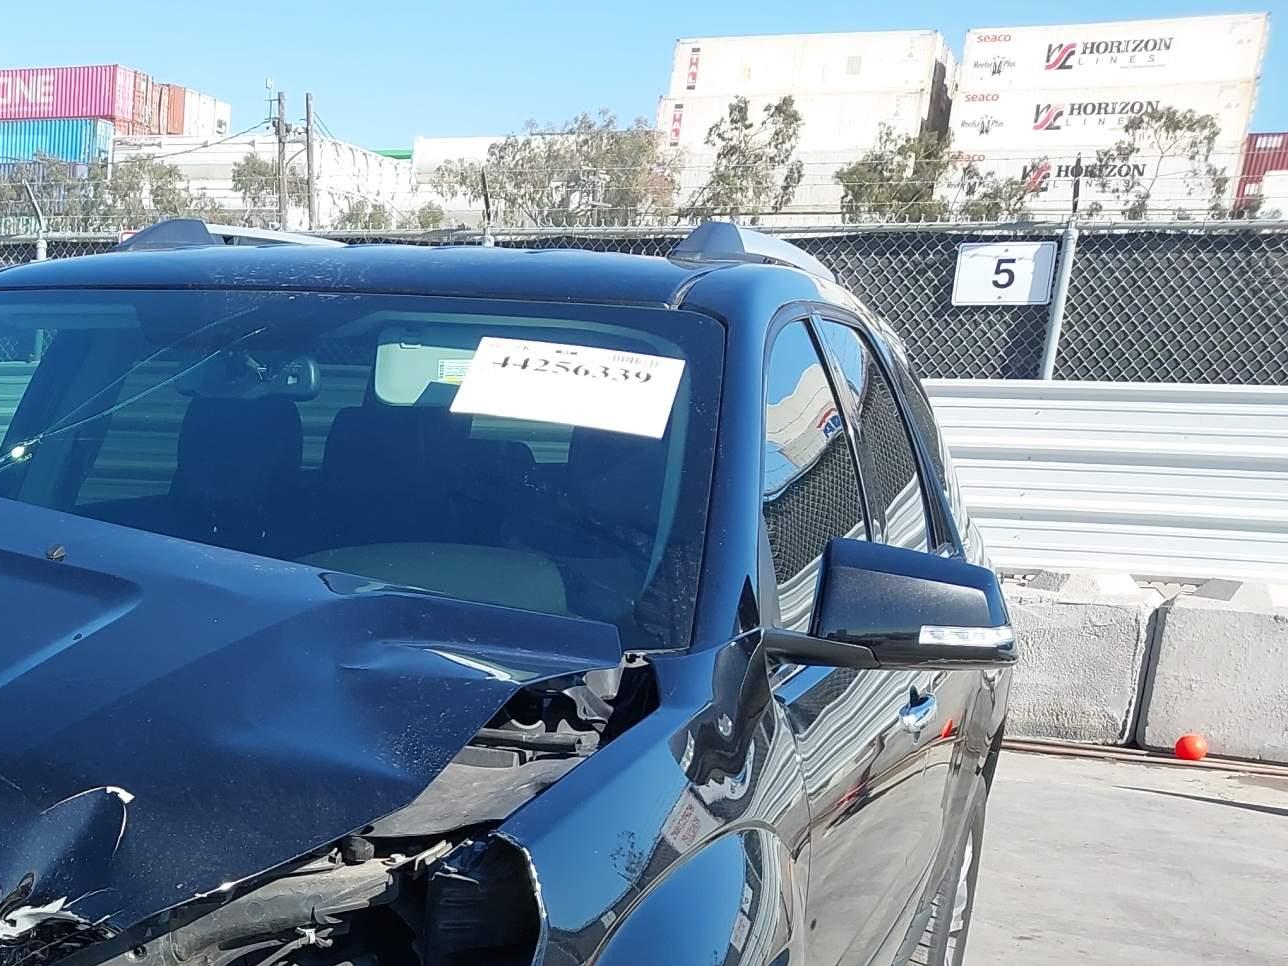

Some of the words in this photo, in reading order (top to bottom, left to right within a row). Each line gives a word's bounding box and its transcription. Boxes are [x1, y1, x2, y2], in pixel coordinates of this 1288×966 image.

[977, 34, 1011, 43] seaco
[1080, 37, 1174, 55] HORIZON
[1078, 54, 1155, 66] LINES
[964, 93, 1000, 103] seaco
[1068, 101, 1161, 116] HORIZON
[992, 258, 1016, 289] 5
[492, 355, 652, 384] 44256339
